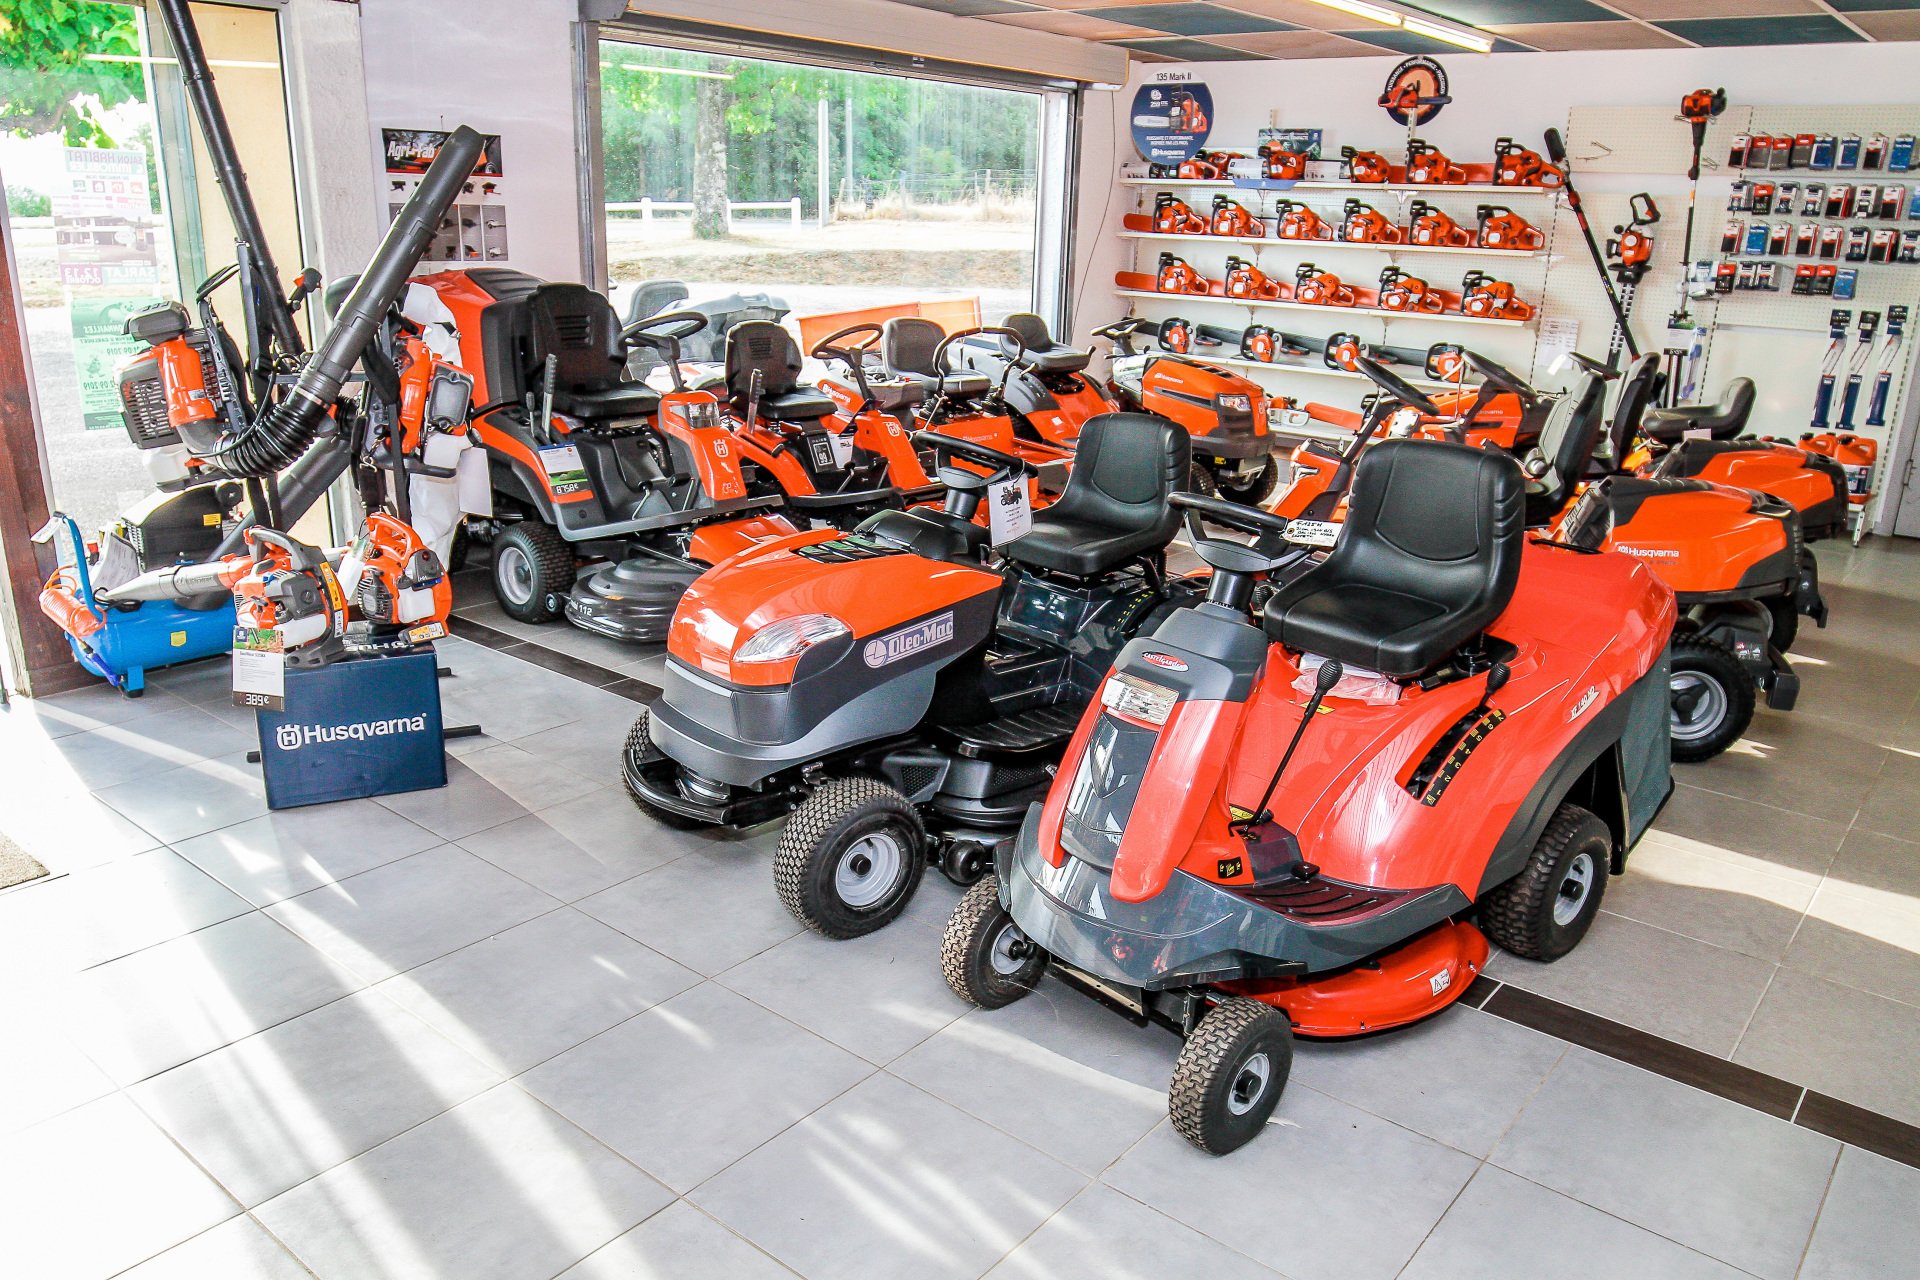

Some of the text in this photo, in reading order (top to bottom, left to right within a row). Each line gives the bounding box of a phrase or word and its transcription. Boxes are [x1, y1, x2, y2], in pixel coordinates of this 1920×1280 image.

[1169, 72, 1186, 80] Mark
[1628, 547, 1680, 558] Husqvarna
[579, 604, 593, 616] 112
[303, 715, 425, 744] Husqvarna
